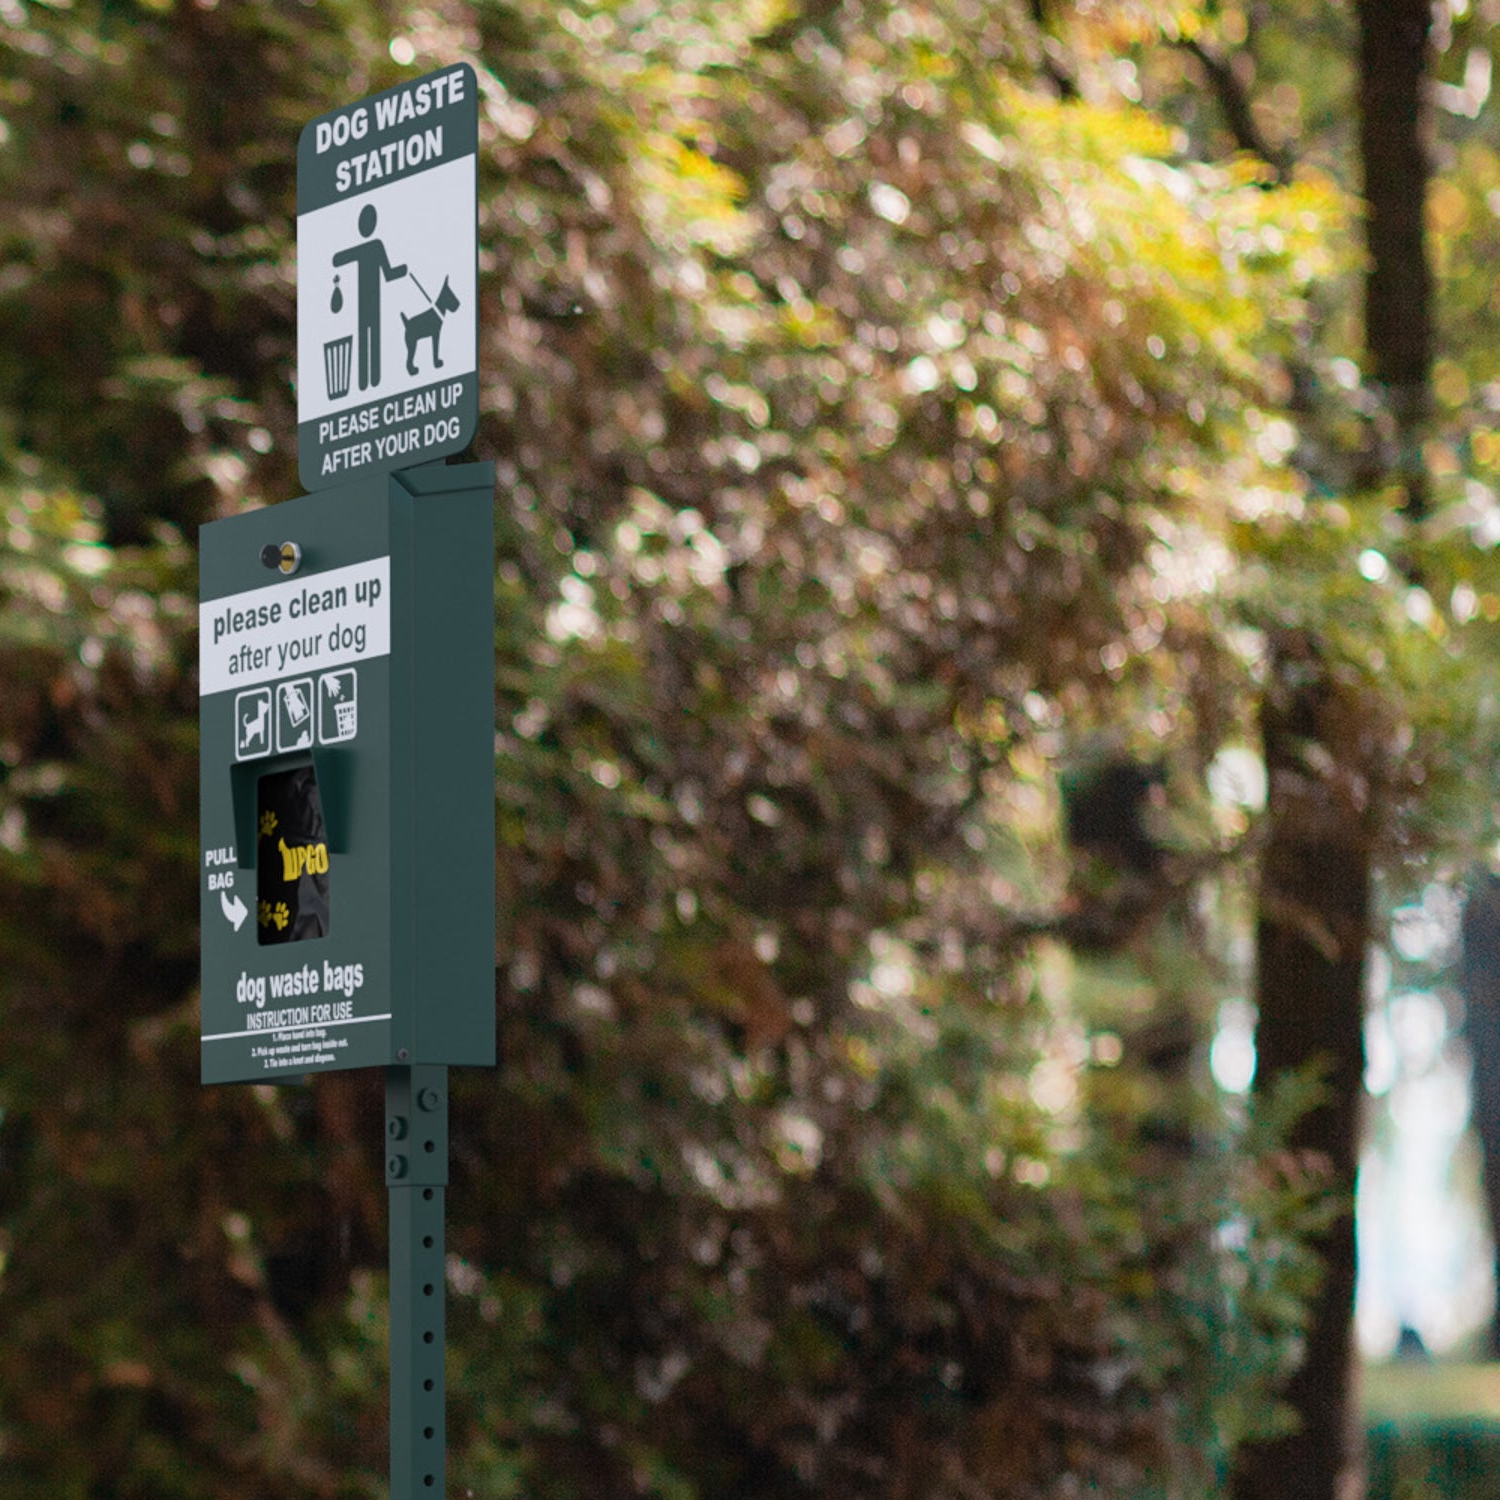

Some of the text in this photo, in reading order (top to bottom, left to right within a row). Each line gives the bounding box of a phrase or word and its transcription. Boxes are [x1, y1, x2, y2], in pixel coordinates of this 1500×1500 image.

[316, 70, 465, 154] DOG WASTE
[335, 126, 443, 192] STATION
[319, 382, 463, 444] PLEASE CLEAN UP
[321, 417, 460, 475] AFTER YOUR DOG
[213, 577, 381, 644] please clean up
[228, 623, 366, 675] after your dog
[205, 847, 237, 867] PULL
[208, 871, 234, 890] BAG
[236, 960, 364, 1008] dog waste bags
[247, 1001, 353, 1030] INSTRUCTION FOR USE
